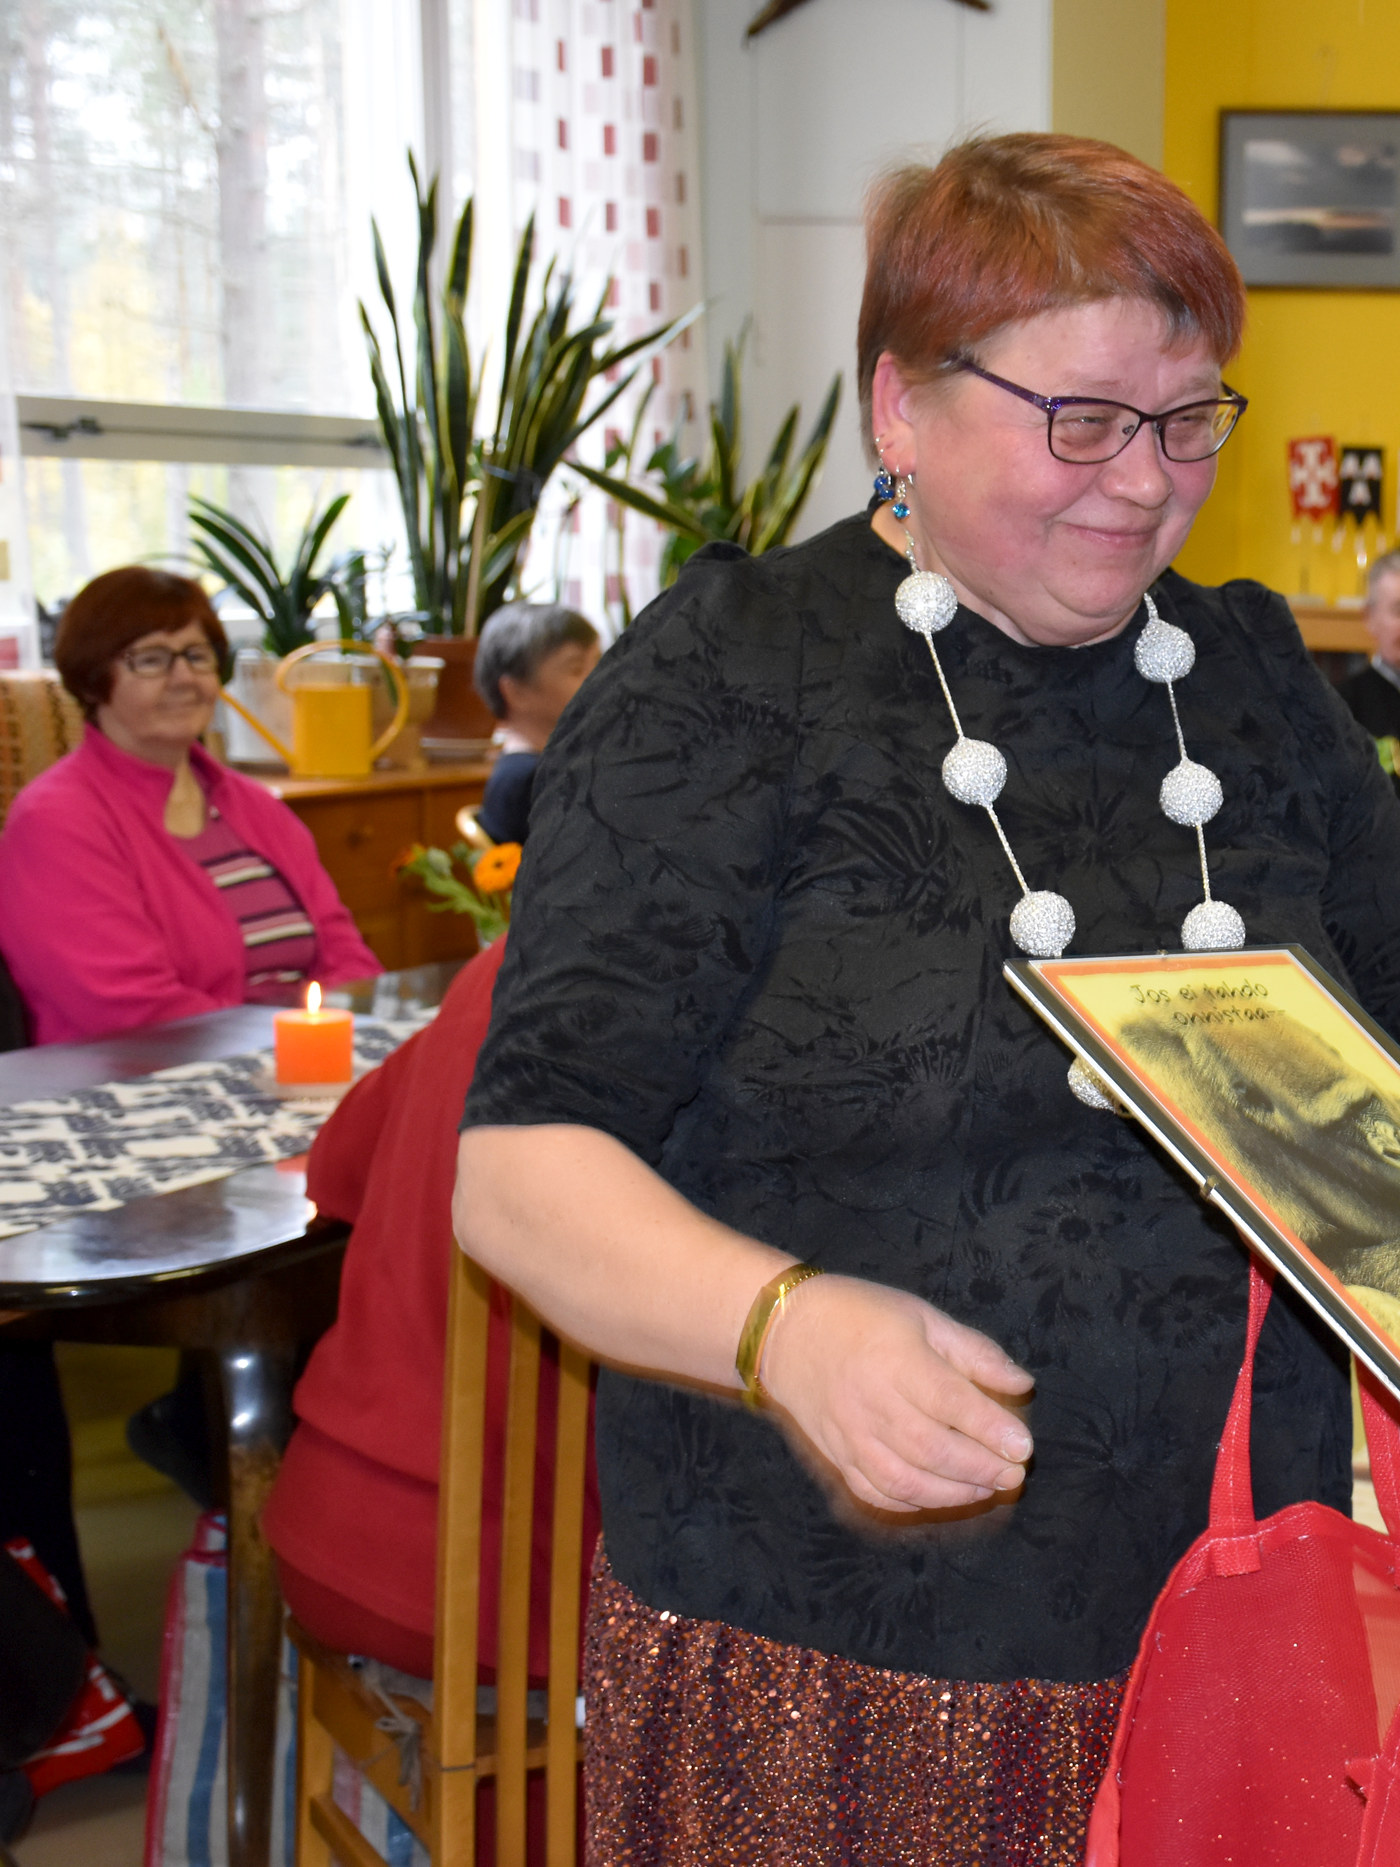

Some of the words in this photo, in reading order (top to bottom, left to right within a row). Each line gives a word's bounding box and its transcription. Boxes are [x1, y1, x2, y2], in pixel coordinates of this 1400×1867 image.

[1130, 984, 1171, 1003] Jos
[1179, 984, 1198, 1001] ei
[1203, 979, 1269, 1003] tahdo
